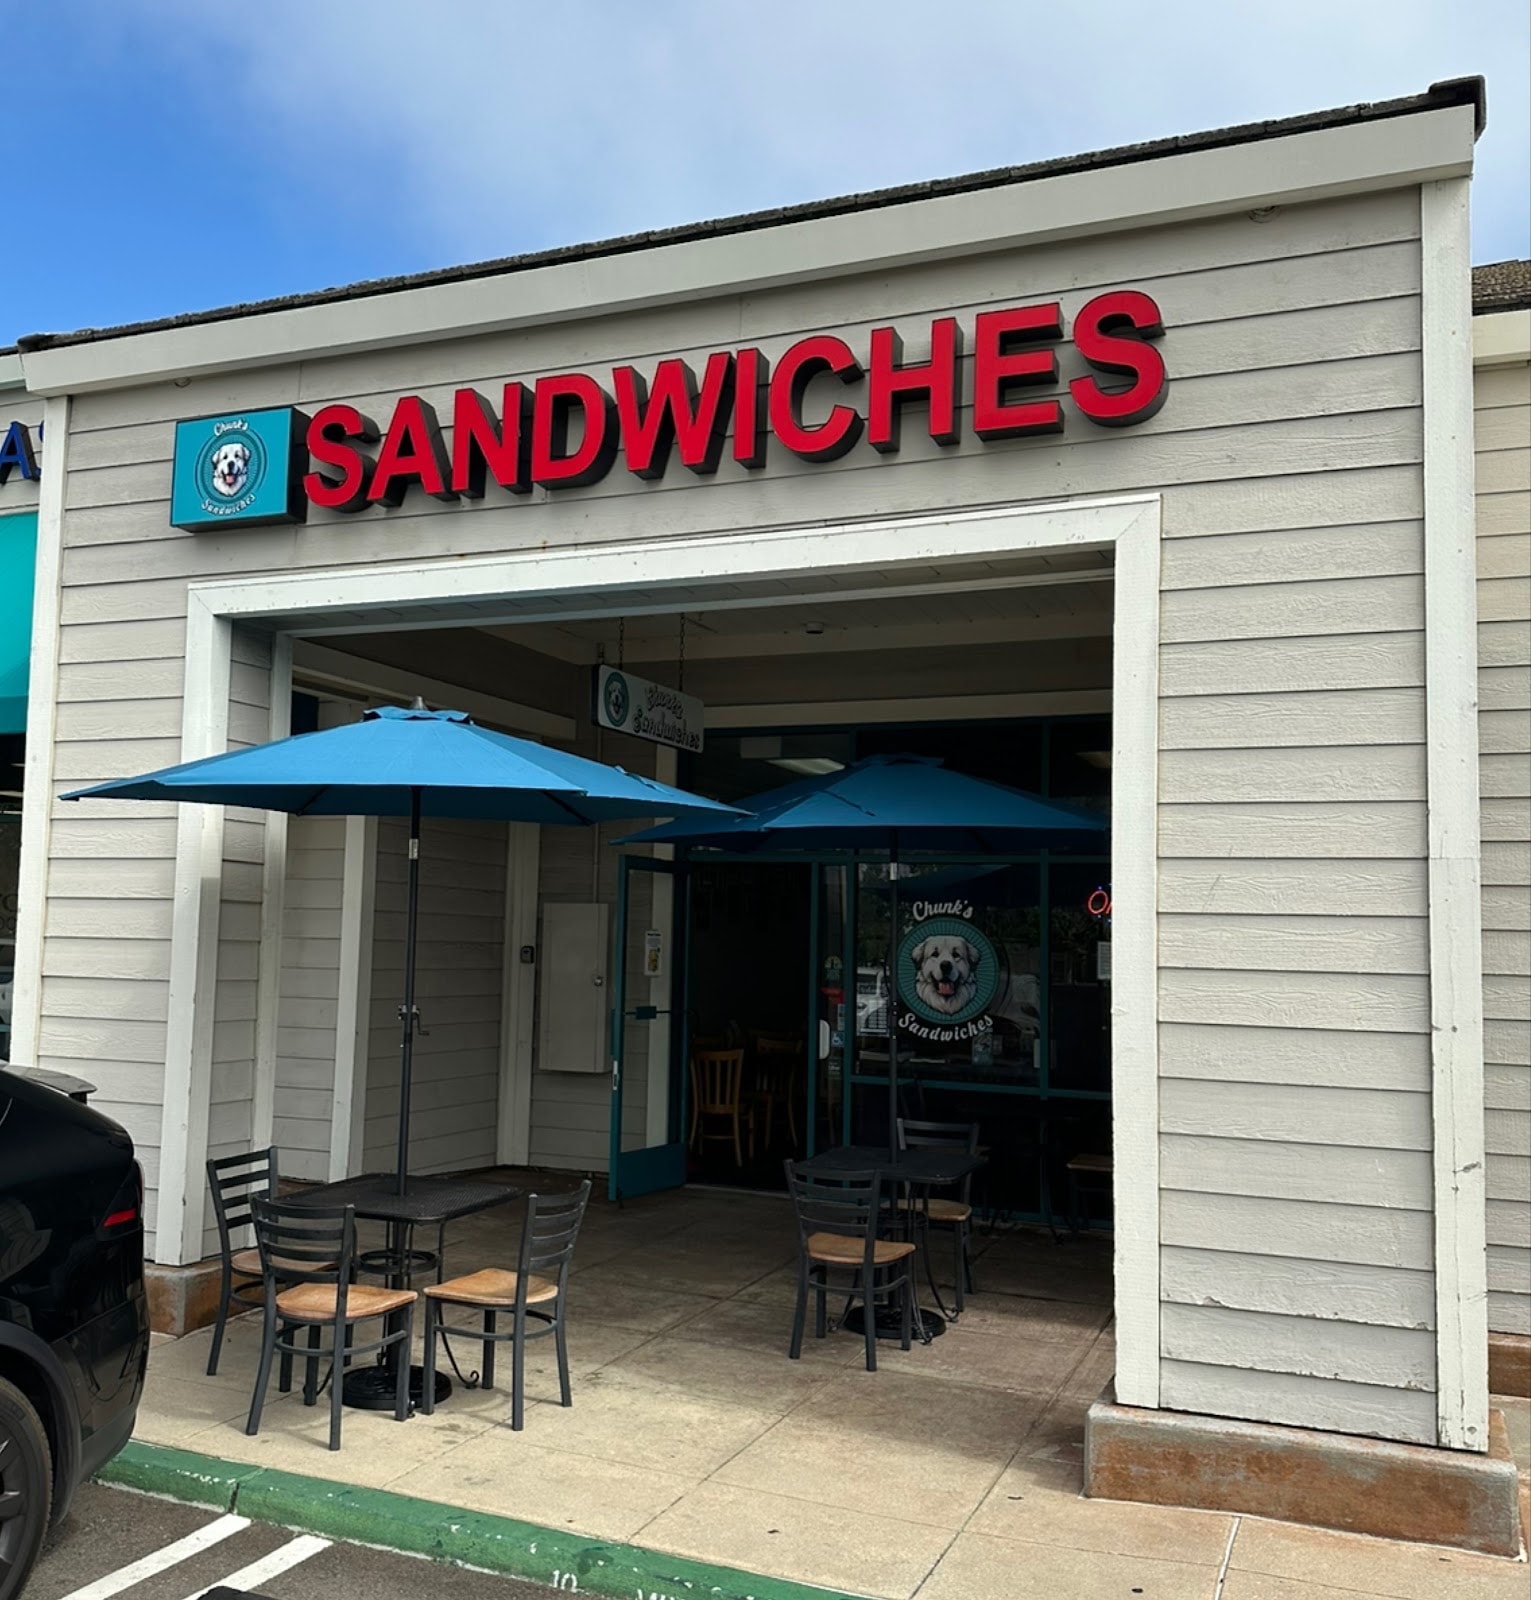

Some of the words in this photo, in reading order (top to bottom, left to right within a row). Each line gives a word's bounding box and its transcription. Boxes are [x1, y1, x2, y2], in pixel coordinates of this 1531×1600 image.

[303, 289, 1167, 509] SANDWICHES
[0, 420, 45, 481] A
[201, 494, 256, 515] Sandwiches
[912, 899, 974, 922] Chunk's
[898, 1012, 994, 1042] Sandwiches
[553, 1569, 577, 1593] 10
